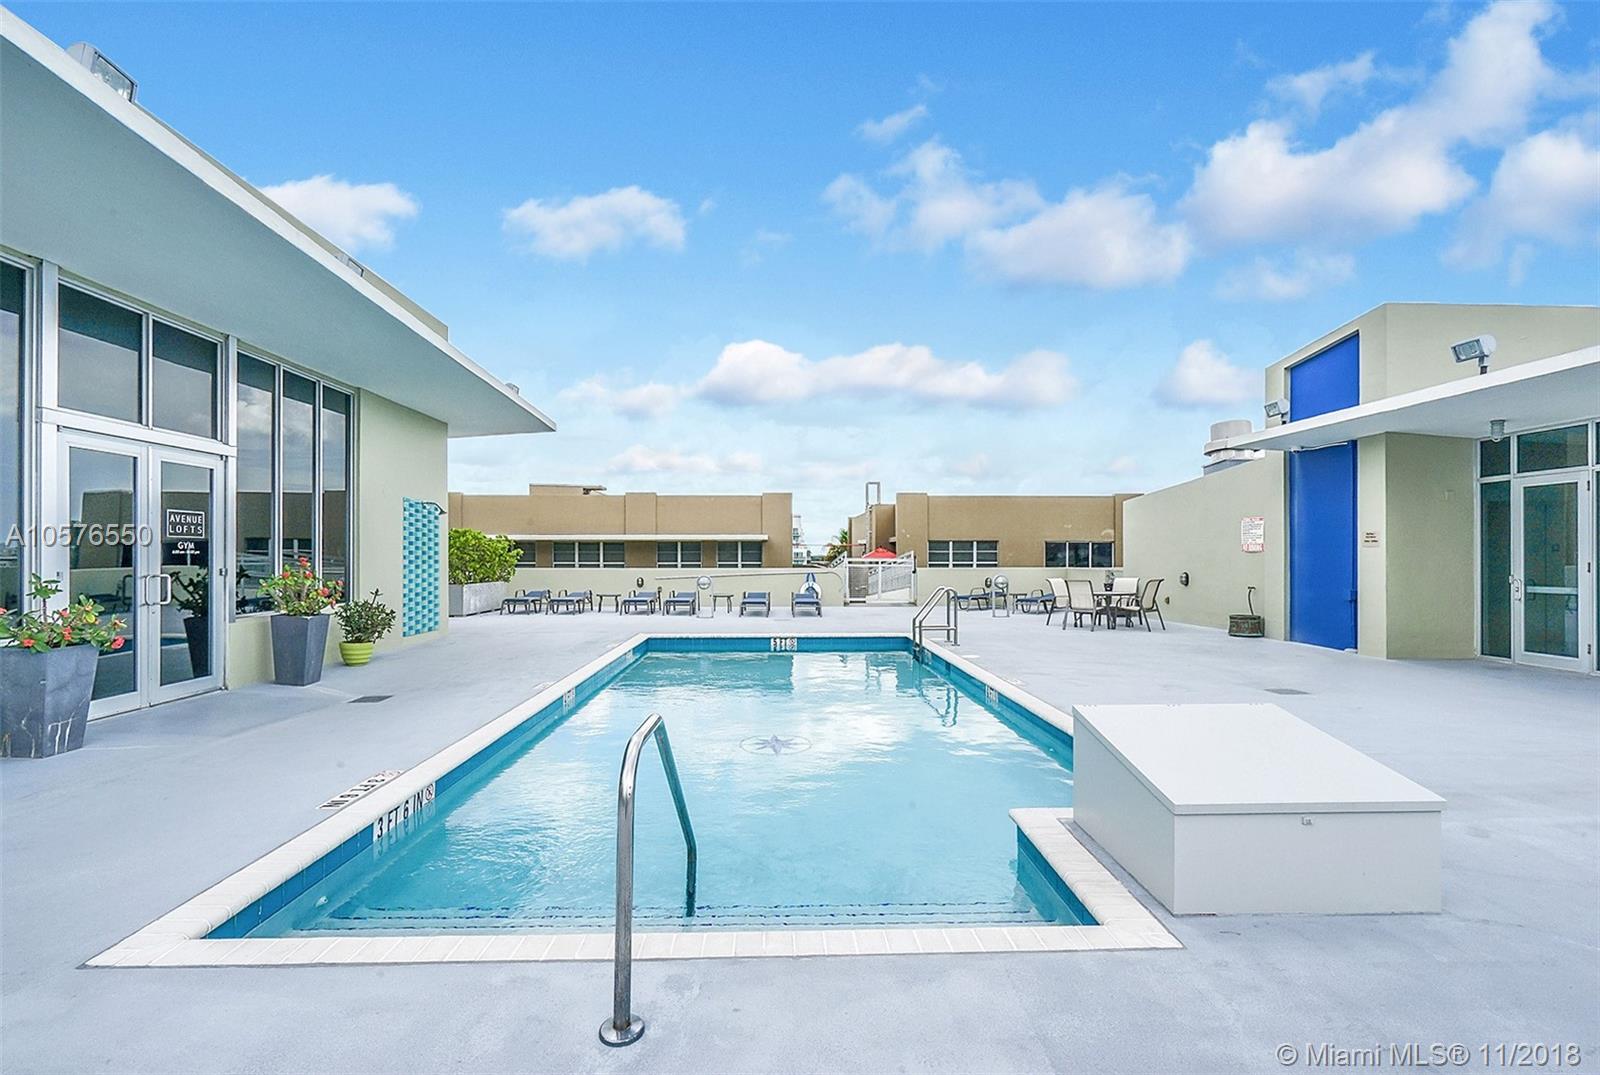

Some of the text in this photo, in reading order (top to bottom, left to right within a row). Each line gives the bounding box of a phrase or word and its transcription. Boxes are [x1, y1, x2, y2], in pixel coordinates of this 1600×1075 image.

[169, 514, 202, 524] AVENUE
[169, 525, 203, 535] LOFTS
[177, 541, 195, 550] GYM
[377, 789, 424, 839] 3 FT 6 IN
